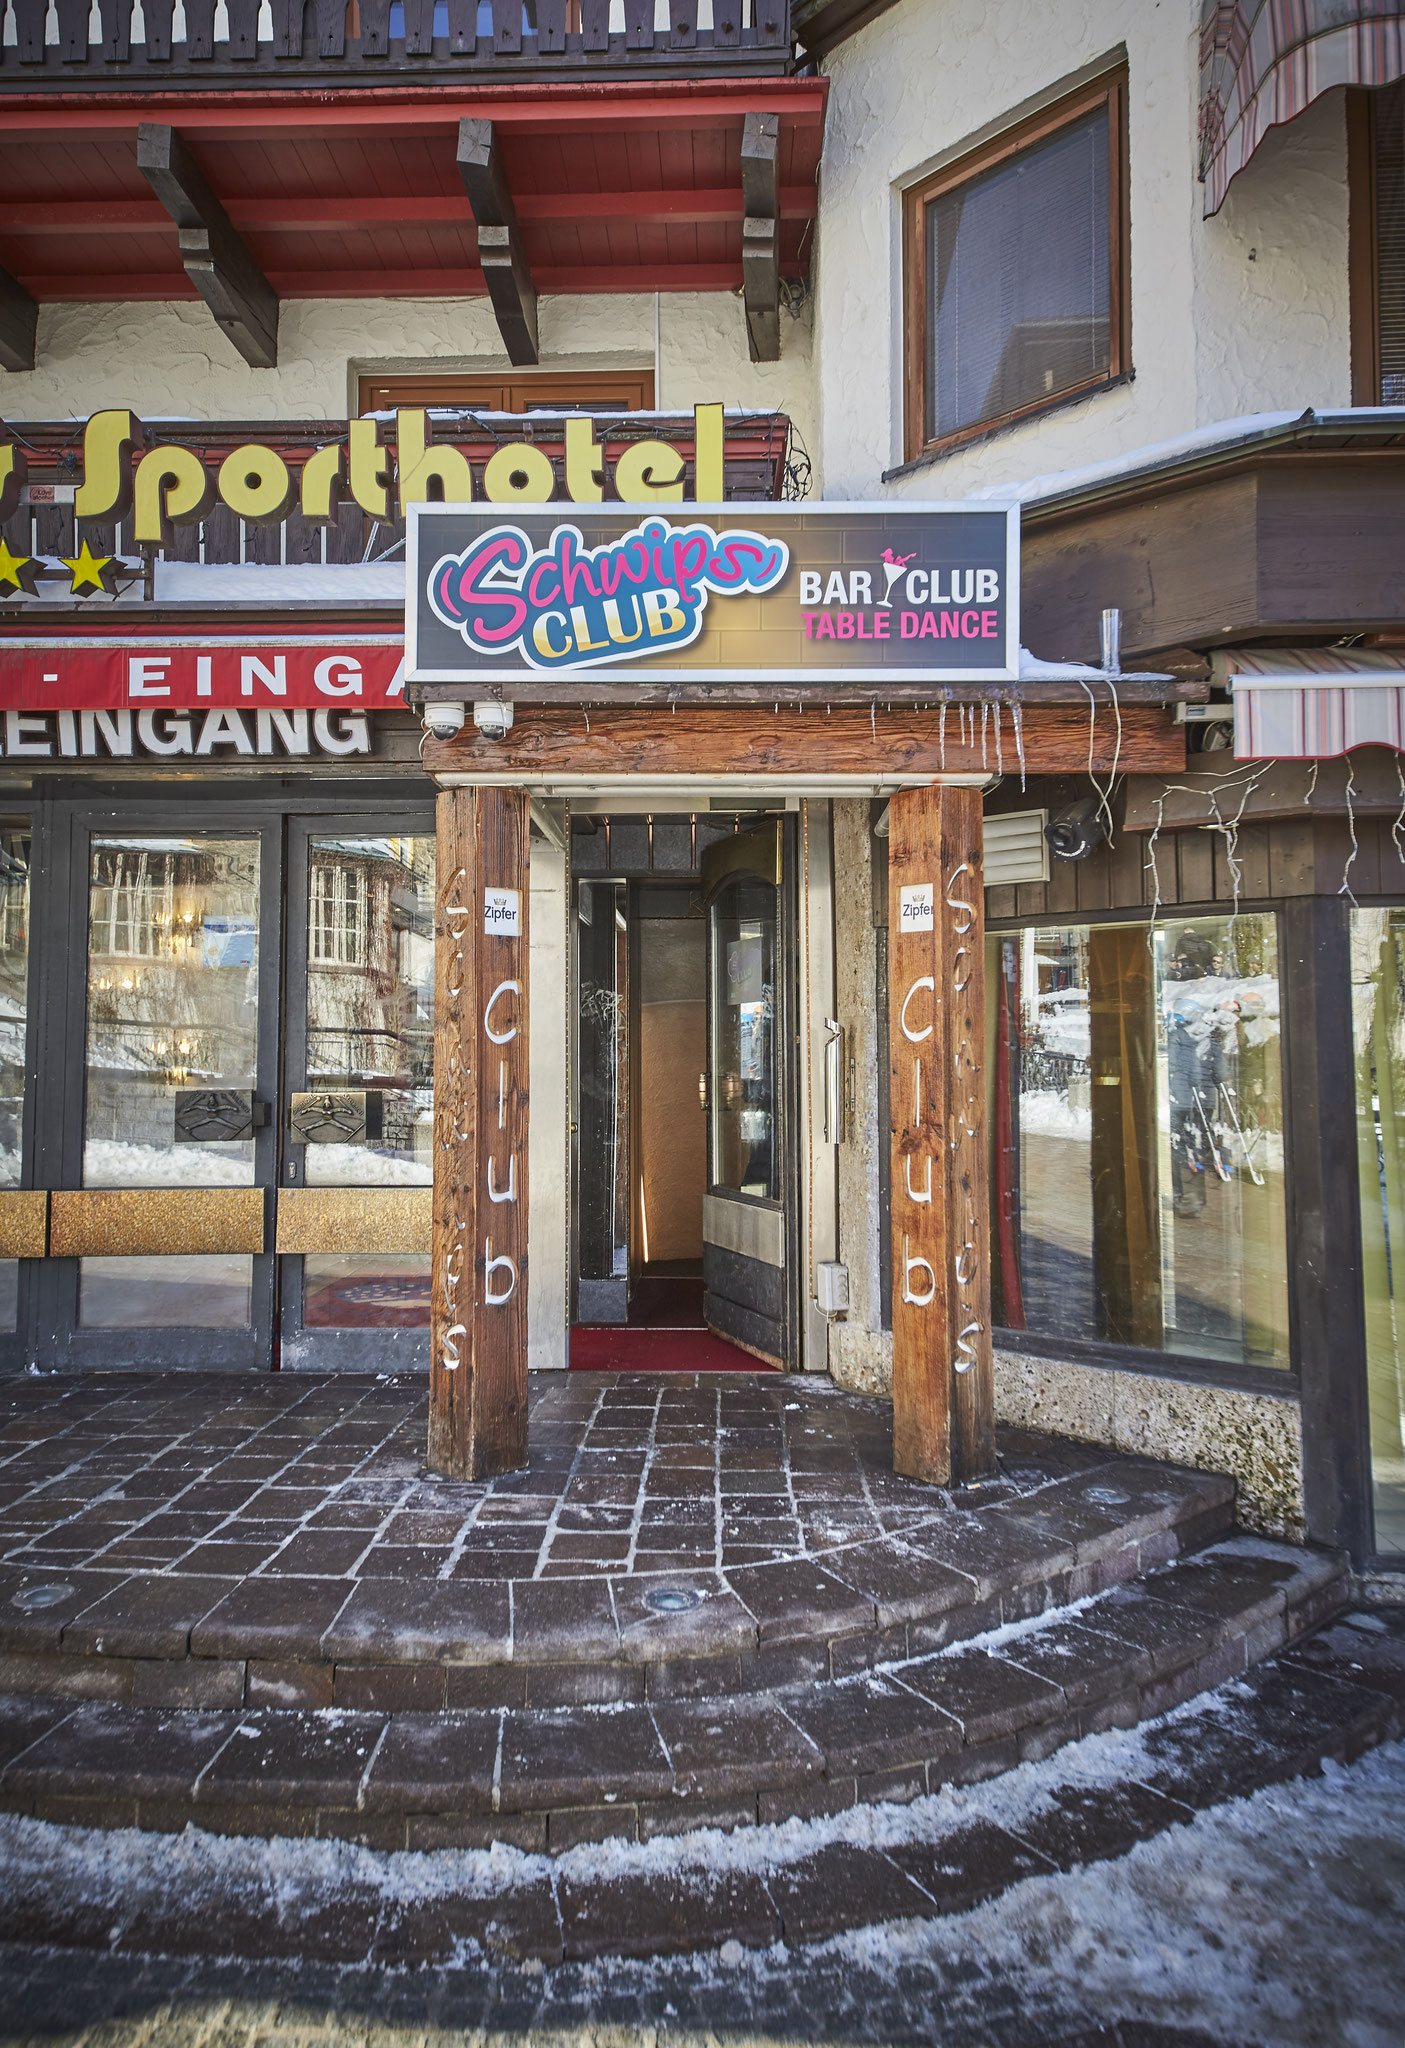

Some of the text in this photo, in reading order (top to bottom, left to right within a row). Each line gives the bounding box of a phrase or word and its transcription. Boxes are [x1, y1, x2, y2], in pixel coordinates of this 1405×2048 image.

[75, 403, 724, 541] Sporthotel
[459, 529, 764, 642] Schwips
[799, 568, 1000, 605] BAR CLUB
[531, 587, 687, 659] CLUB
[800, 610, 999, 641] TABLE DANCE
[0, 709, 372, 757] EINGANG
[484, 905, 517, 923] Zipfer
[484, 978, 524, 1307] Club
[901, 974, 936, 1308] Club
